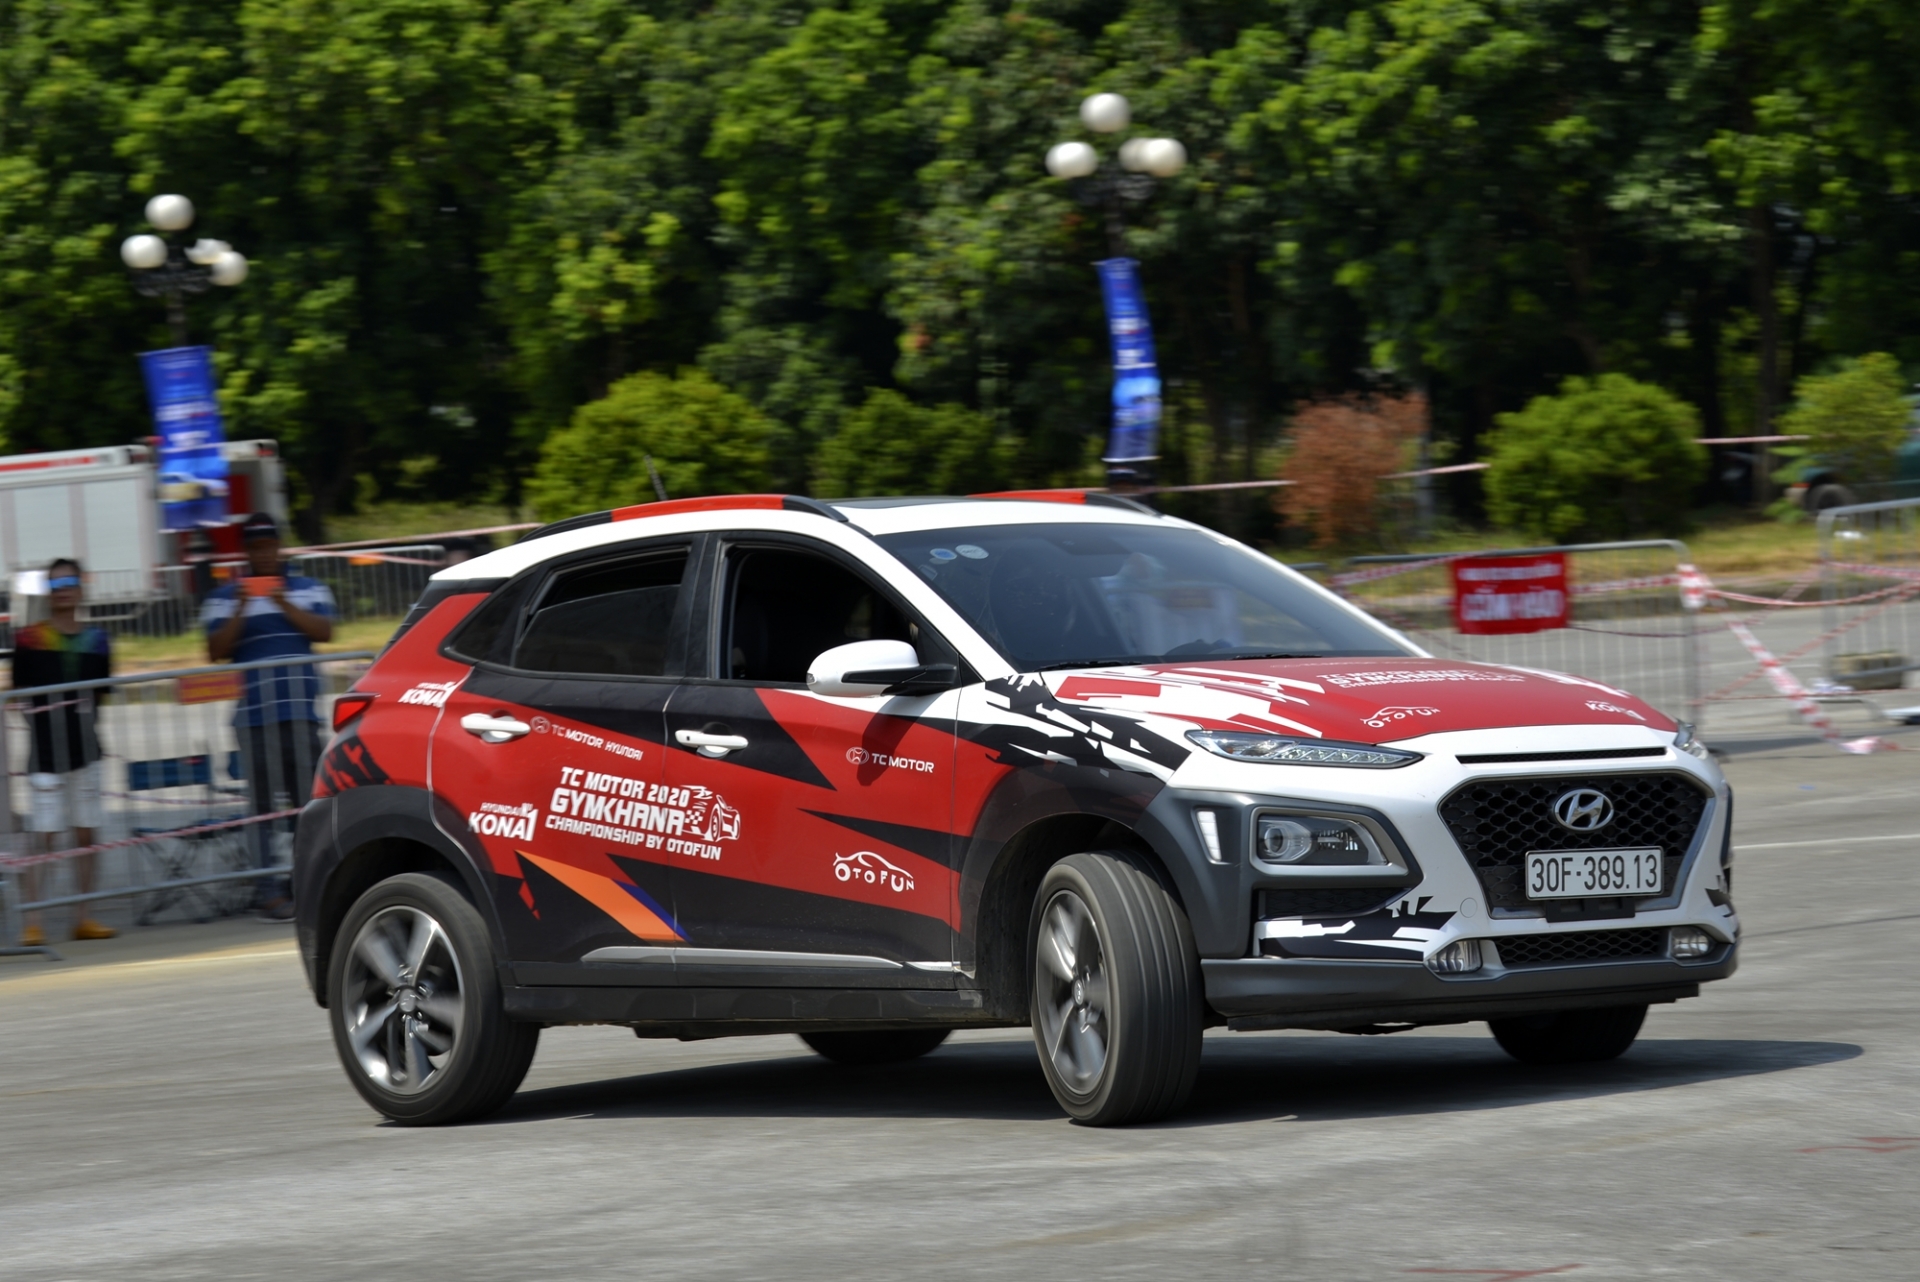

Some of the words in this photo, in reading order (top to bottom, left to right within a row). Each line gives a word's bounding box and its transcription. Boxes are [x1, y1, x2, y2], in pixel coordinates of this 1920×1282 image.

[1367, 708, 1441, 728] OTOFUN
[551, 724, 566, 737] TC
[564, 728, 604, 749] MOTOR
[604, 740, 644, 761] HYUNDAI
[871, 752, 887, 766] TC
[888, 756, 935, 773] MOTOR
[560, 766, 585, 787] TC
[584, 771, 645, 799] MOTOR
[647, 783, 691, 808] 2020
[550, 787, 686, 836] GYMKHANA
[544, 814, 645, 846] CHAMPIONSHIP
[645, 834, 664, 850] BY
[665, 838, 722, 861] OTOFUN
[834, 862, 915, 893] OTOFUN
[1531, 854, 1658, 893] 30F-389.13
